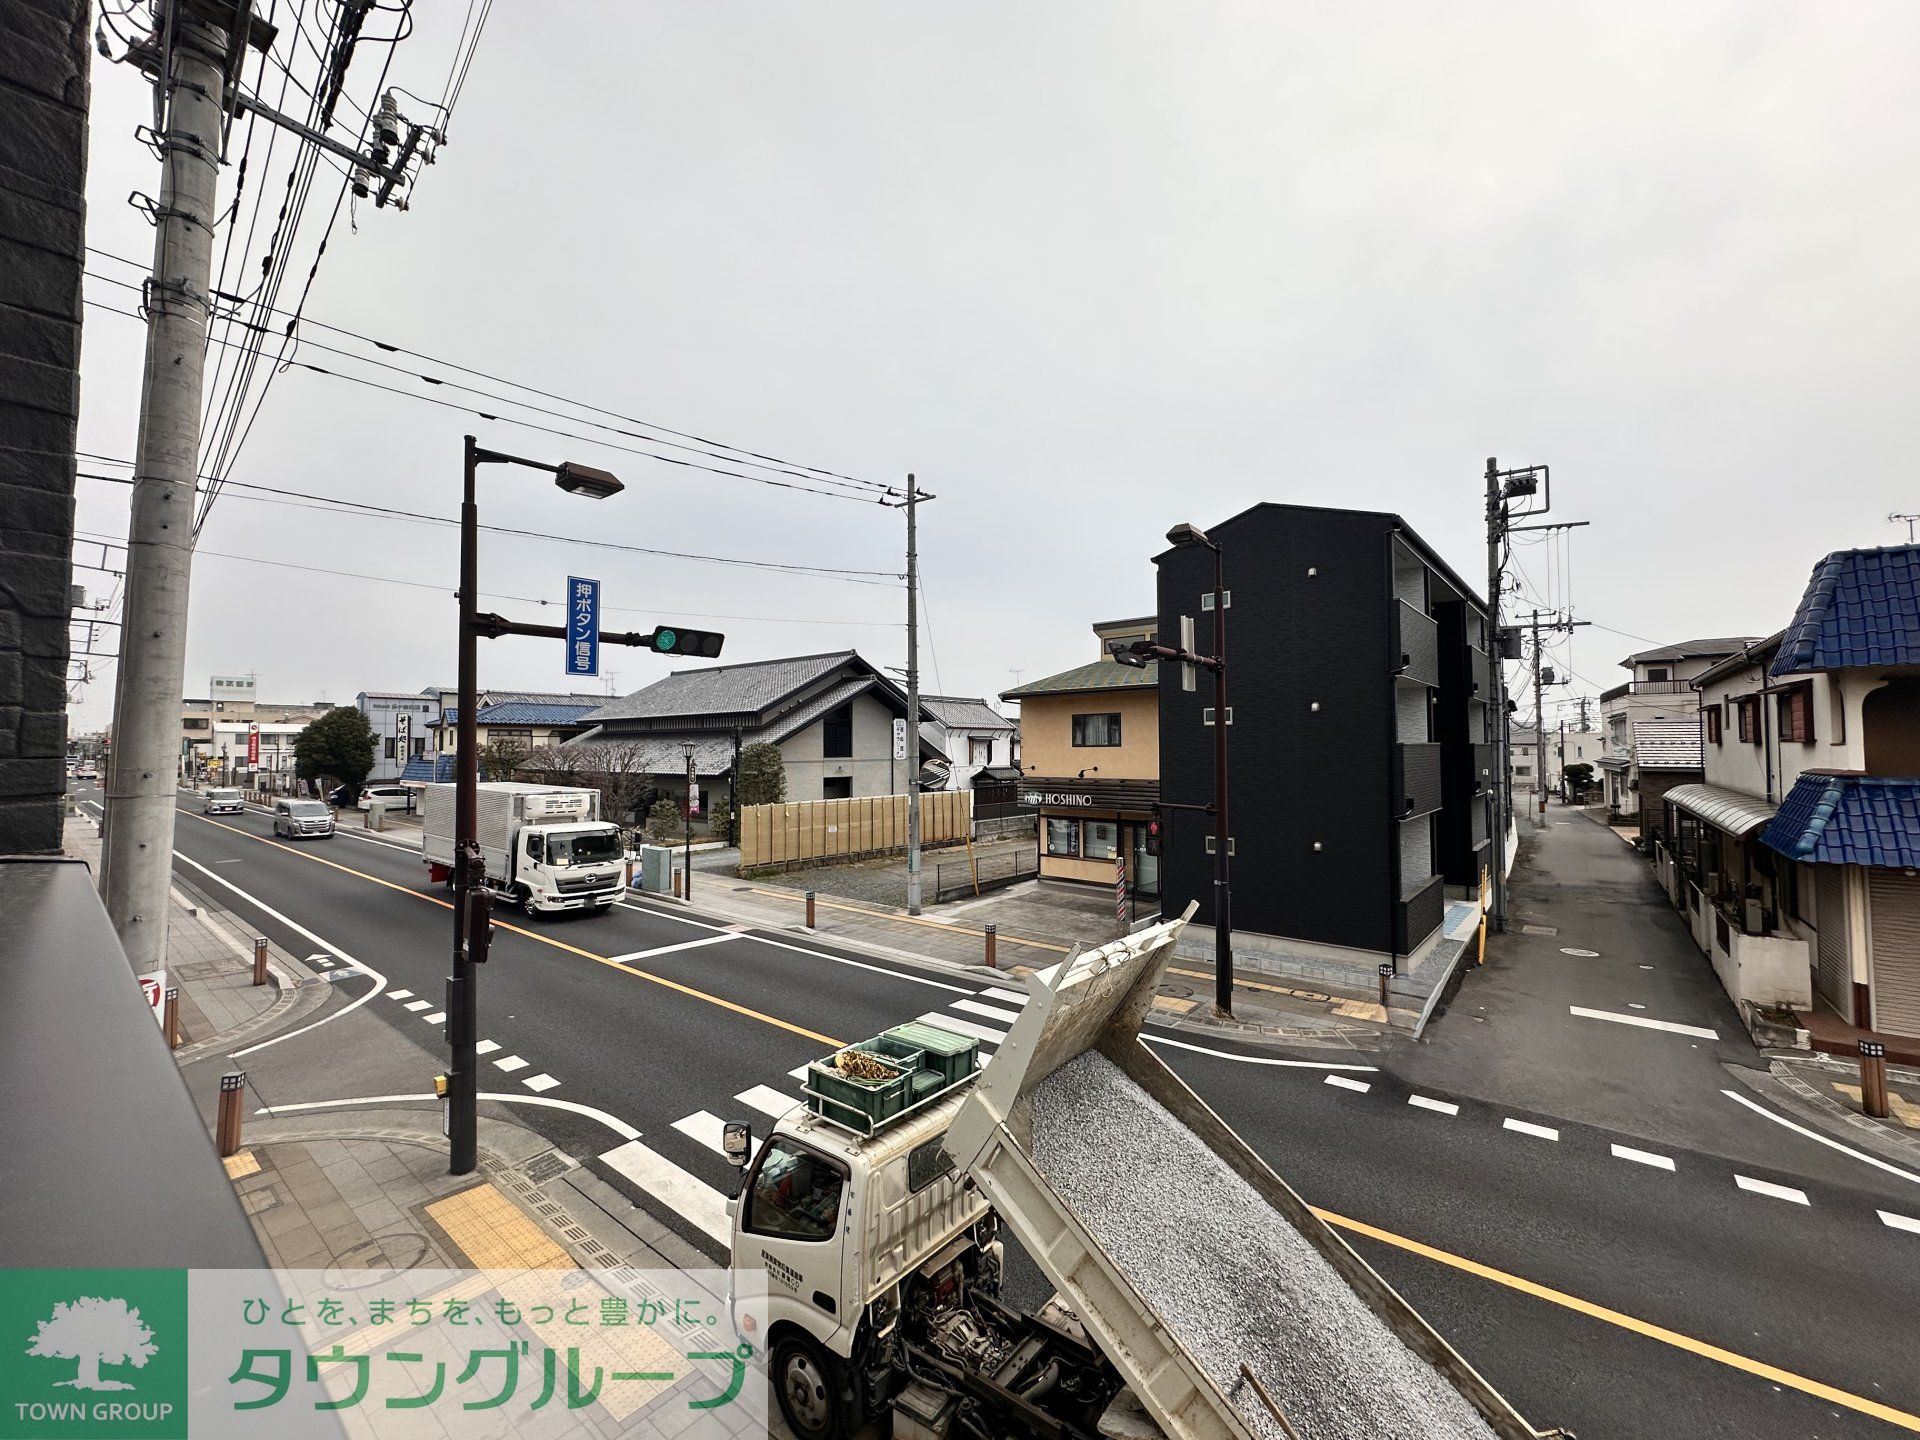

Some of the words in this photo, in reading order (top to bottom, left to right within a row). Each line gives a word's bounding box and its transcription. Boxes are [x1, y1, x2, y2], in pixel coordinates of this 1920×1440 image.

[575, 582, 592, 670] 押ボタン信号
[398, 716, 407, 743] そば処
[1045, 793, 1092, 806] HOSHINO
